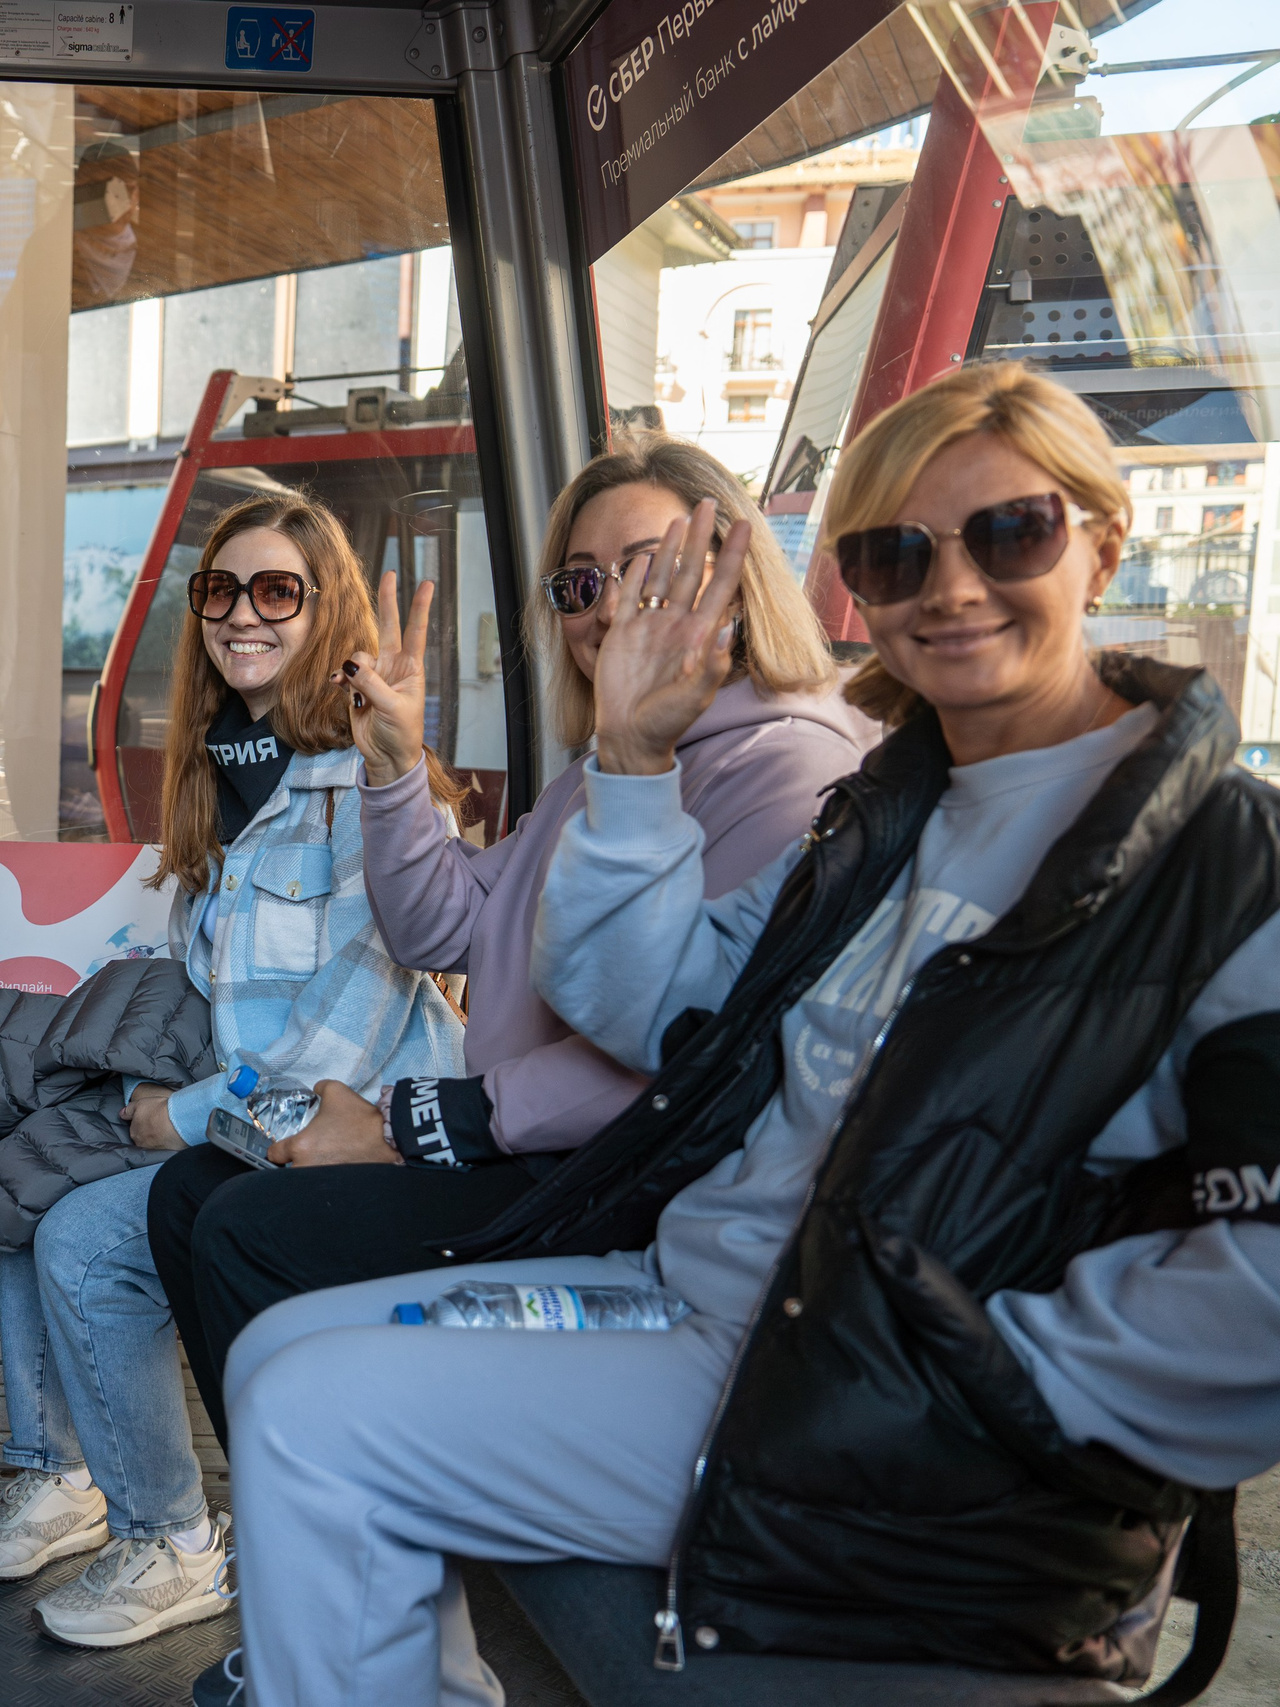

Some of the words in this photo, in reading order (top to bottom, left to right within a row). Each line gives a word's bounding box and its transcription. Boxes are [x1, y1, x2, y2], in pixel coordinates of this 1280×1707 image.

[57, 13, 84, 23] Capacité
[109, 12, 115, 24] 8
[600, 82, 695, 189] Премиальный
[695, 49, 736, 100] банк
[737, 37, 749, 61] с
[752, 0, 808, 50] лайф
[608, 35, 655, 104] СБЕР
[409, 1076, 459, 1167] МЕТ
